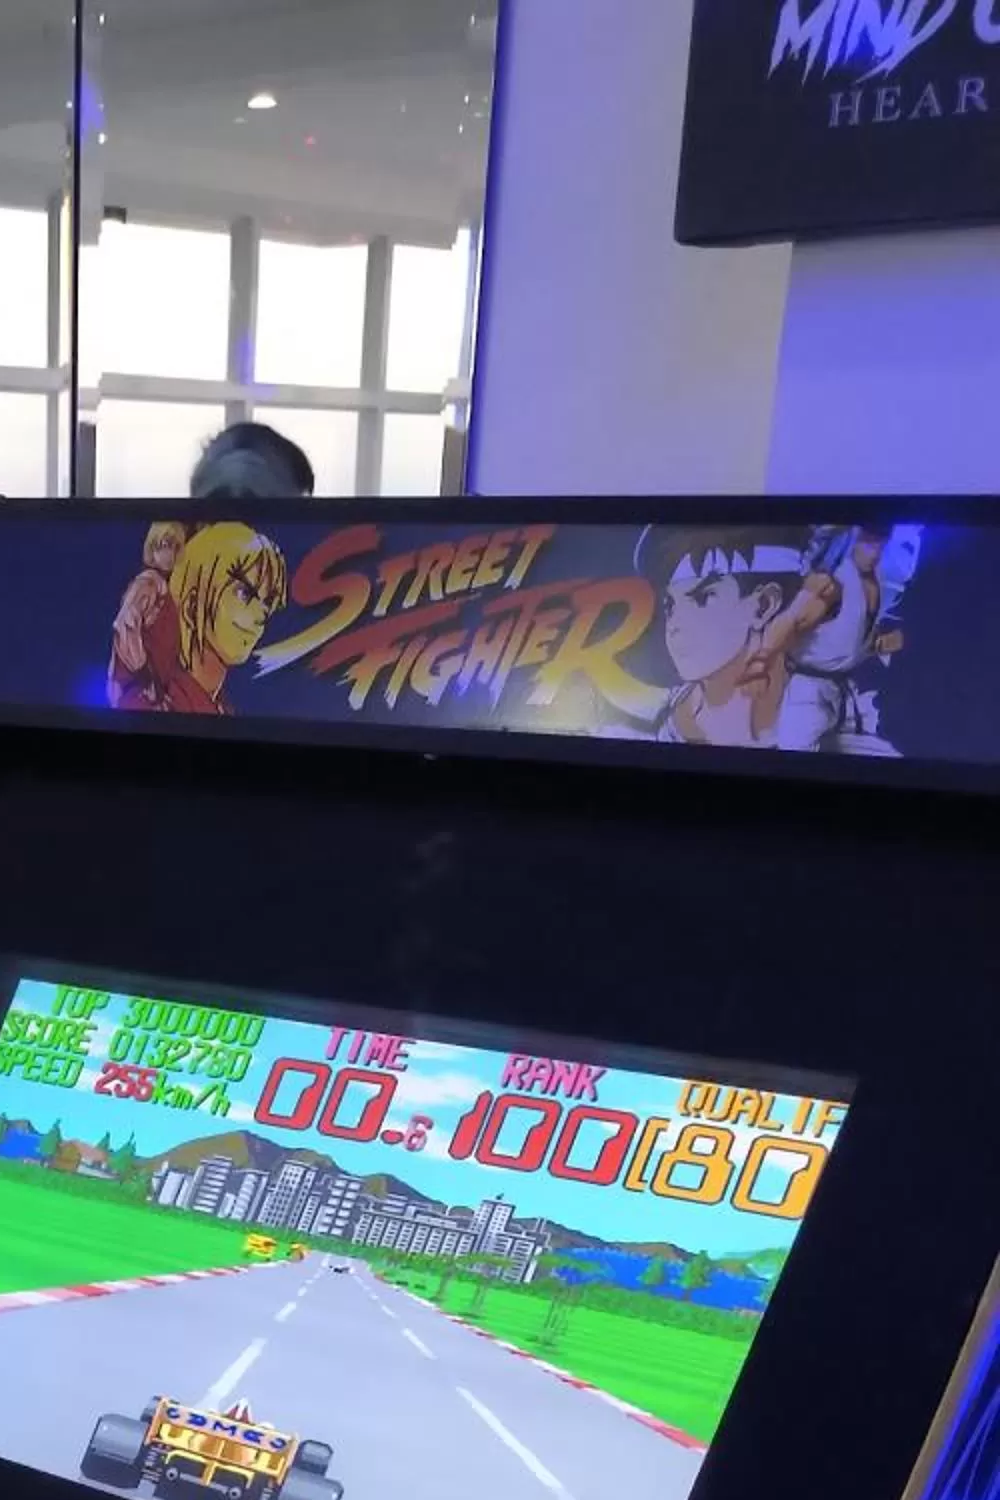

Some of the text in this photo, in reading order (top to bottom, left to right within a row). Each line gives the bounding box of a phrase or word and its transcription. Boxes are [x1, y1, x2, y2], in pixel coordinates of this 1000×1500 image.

[828, 77, 988, 128] HEAR
[251, 523, 558, 679] STREET
[310, 575, 668, 722] FIGHTER
[0, 1009, 98, 1055] SCORE
[50, 984, 110, 1020] TOP
[324, 1027, 850, 1139] TIME RANK QUALIF
[448, 1090, 640, 1187] 100
